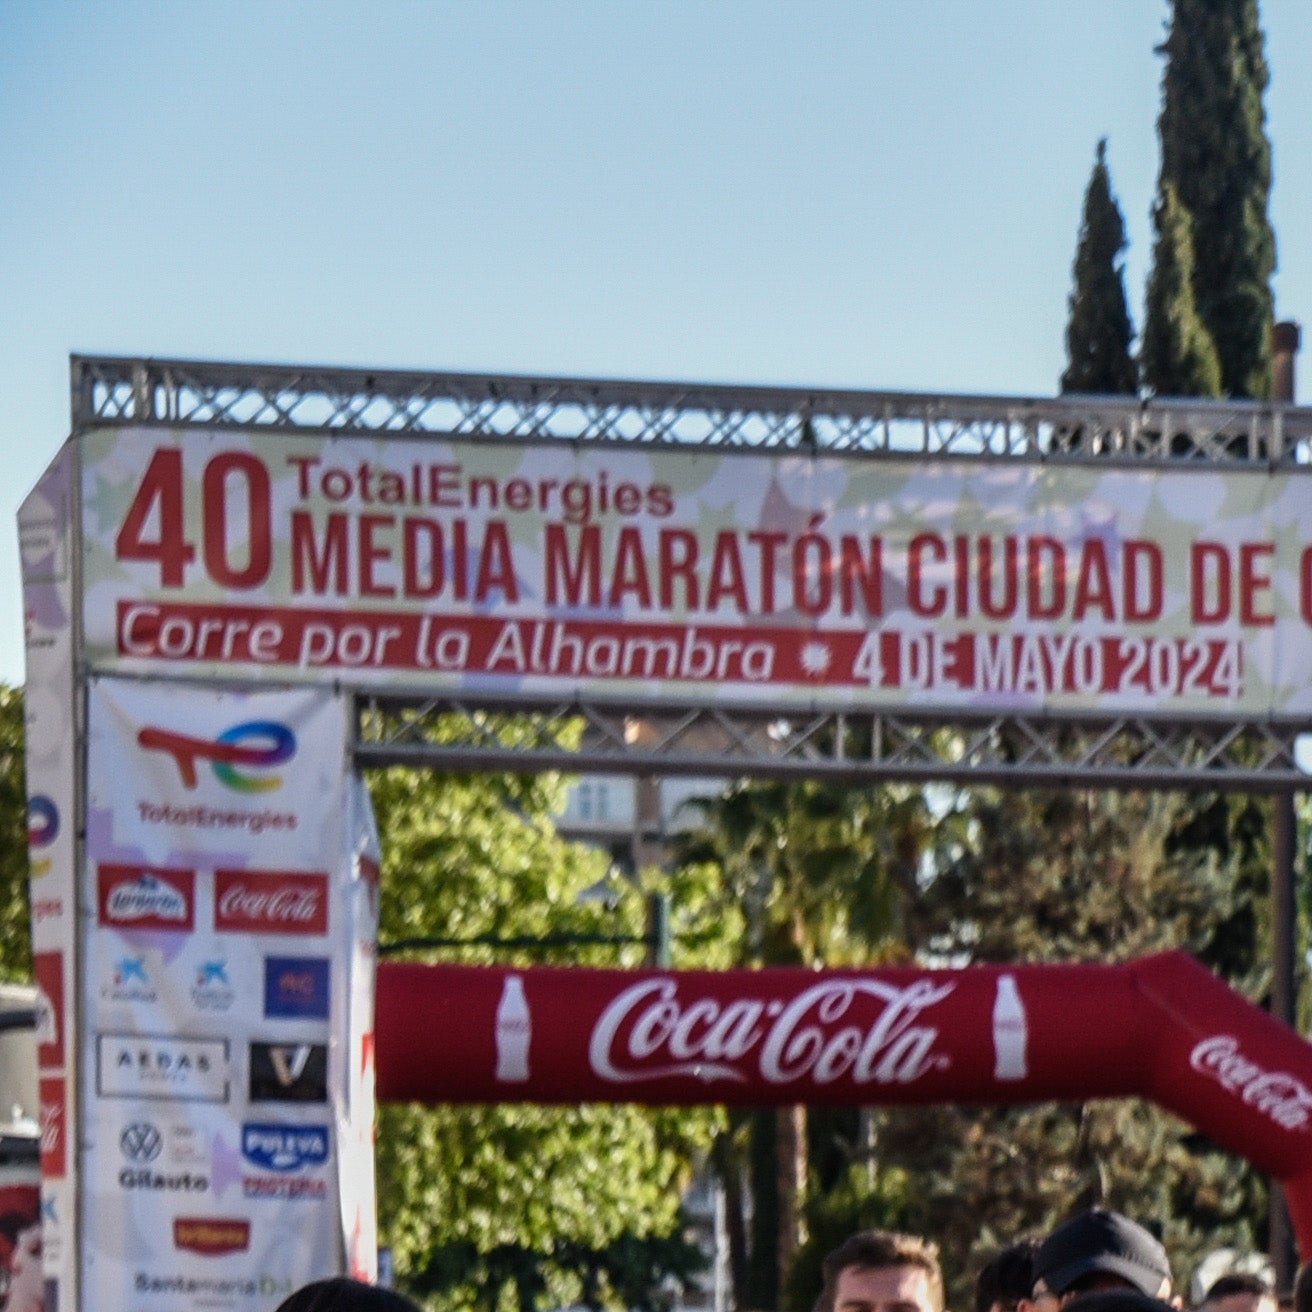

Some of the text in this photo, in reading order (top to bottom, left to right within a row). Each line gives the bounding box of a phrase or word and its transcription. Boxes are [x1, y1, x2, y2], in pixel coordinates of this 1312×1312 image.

[116, 449, 273, 592] 40
[289, 455, 674, 524] TotalEnergies
[290, 513, 519, 601] MEDIA
[544, 514, 884, 619] MARATÓN
[906, 531, 1164, 626] CIUDAD
[1190, 542, 1275, 628] DE
[121, 606, 775, 682] Corre por la Alhambra
[853, 638, 1243, 698] 4 DE MAYO 2024
[138, 801, 298, 833] TotalEnergies
[219, 884, 318, 921] Coca-Cola
[589, 975, 957, 1084] Coca-Cola
